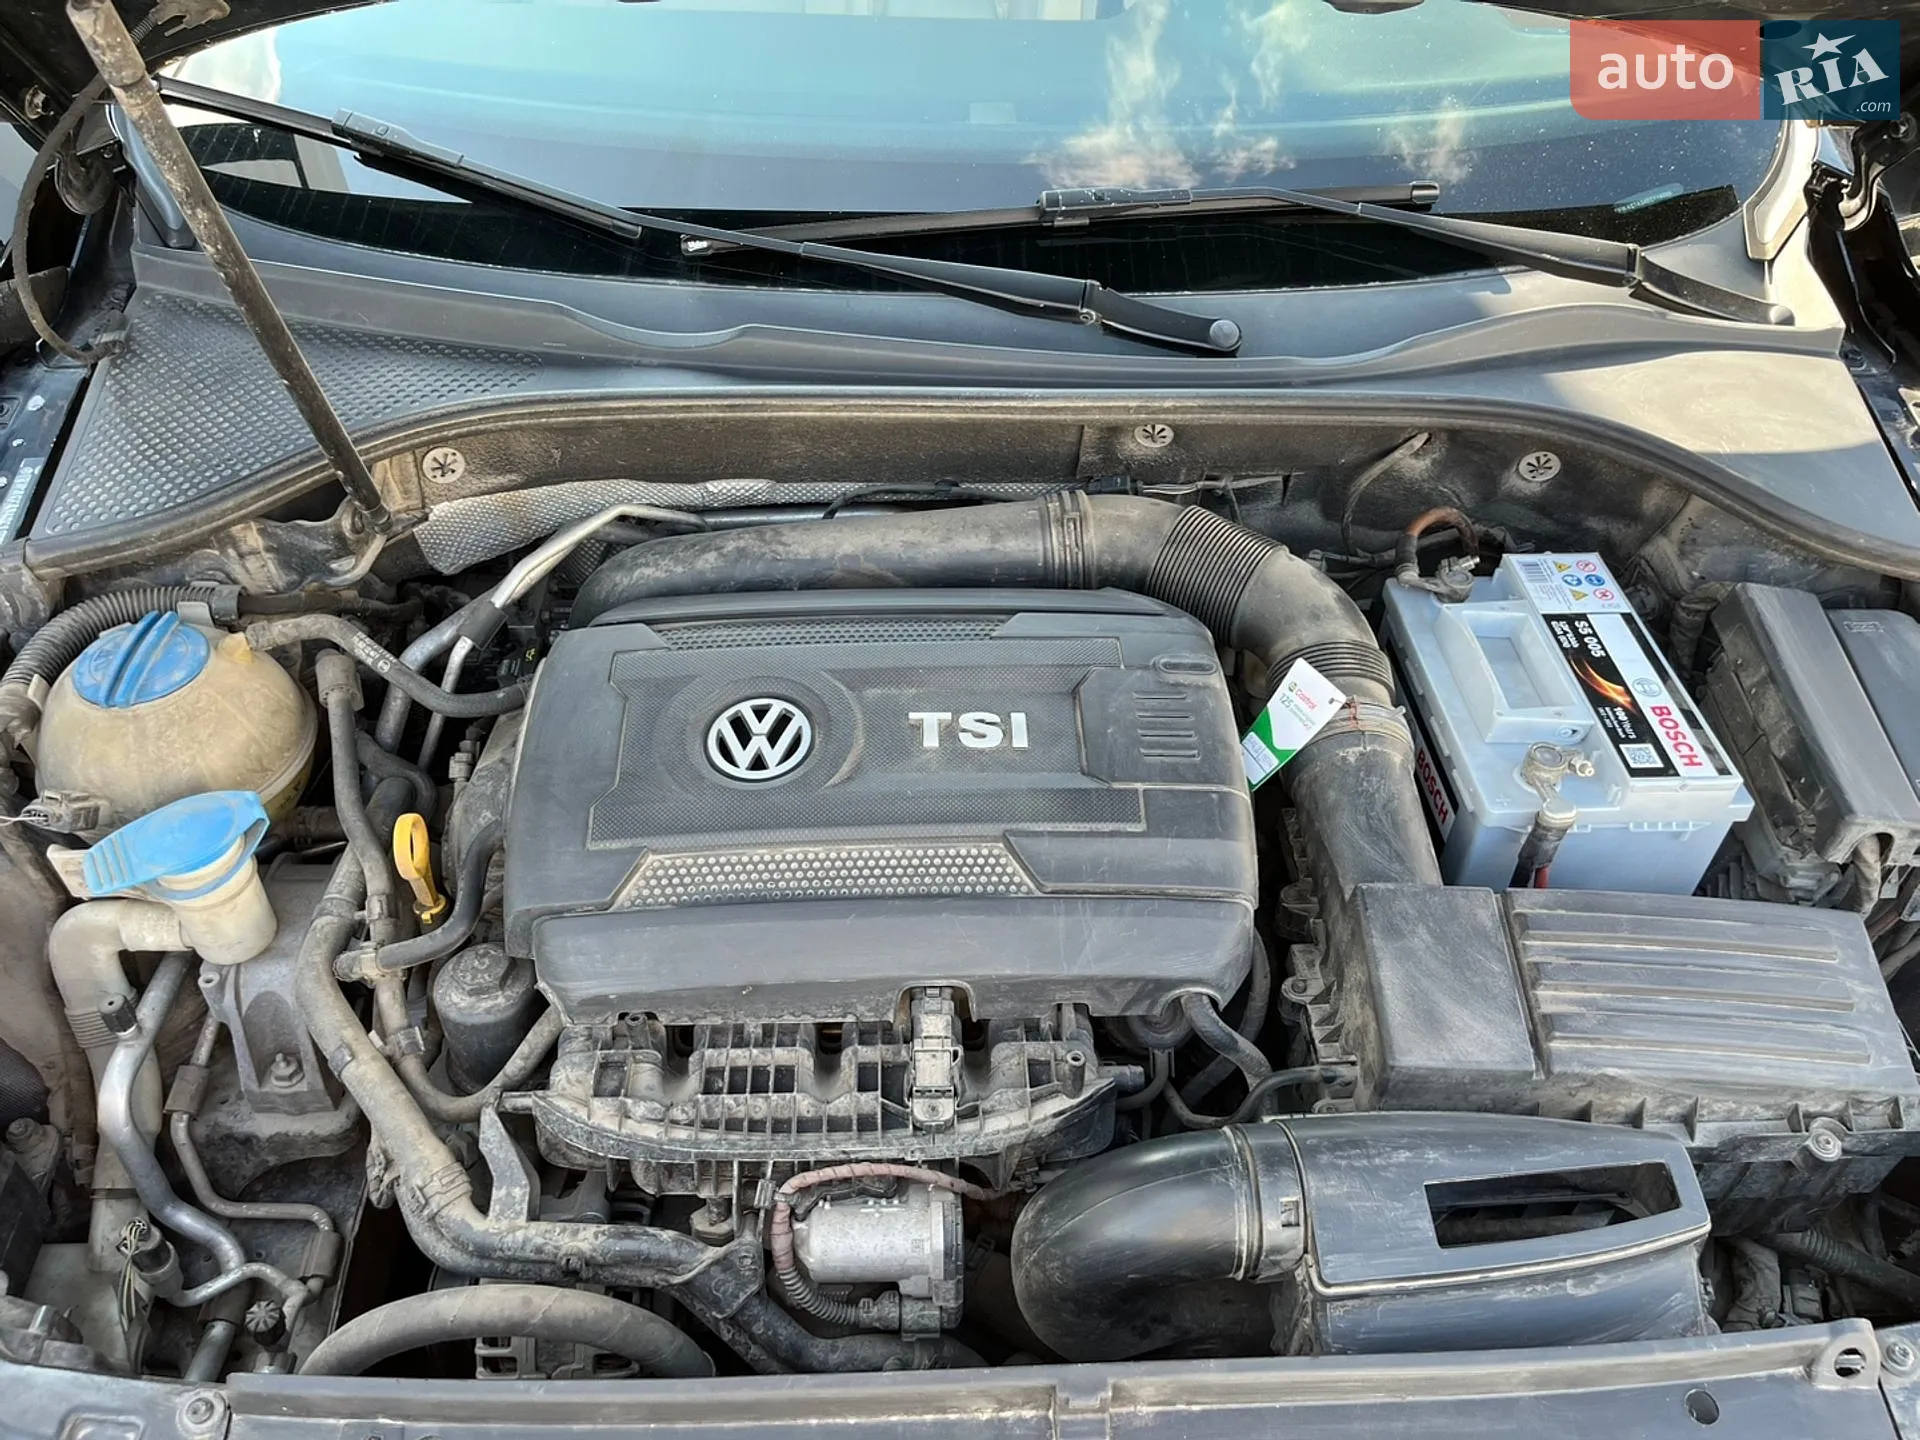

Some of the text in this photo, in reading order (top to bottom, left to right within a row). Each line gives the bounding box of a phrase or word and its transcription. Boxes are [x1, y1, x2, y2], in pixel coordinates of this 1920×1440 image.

[1583, 636, 1606, 658] 005
[908, 711, 1029, 749] TSI
[1650, 705, 1703, 767] BOSCH
[1418, 747, 1448, 825] BOSCH
